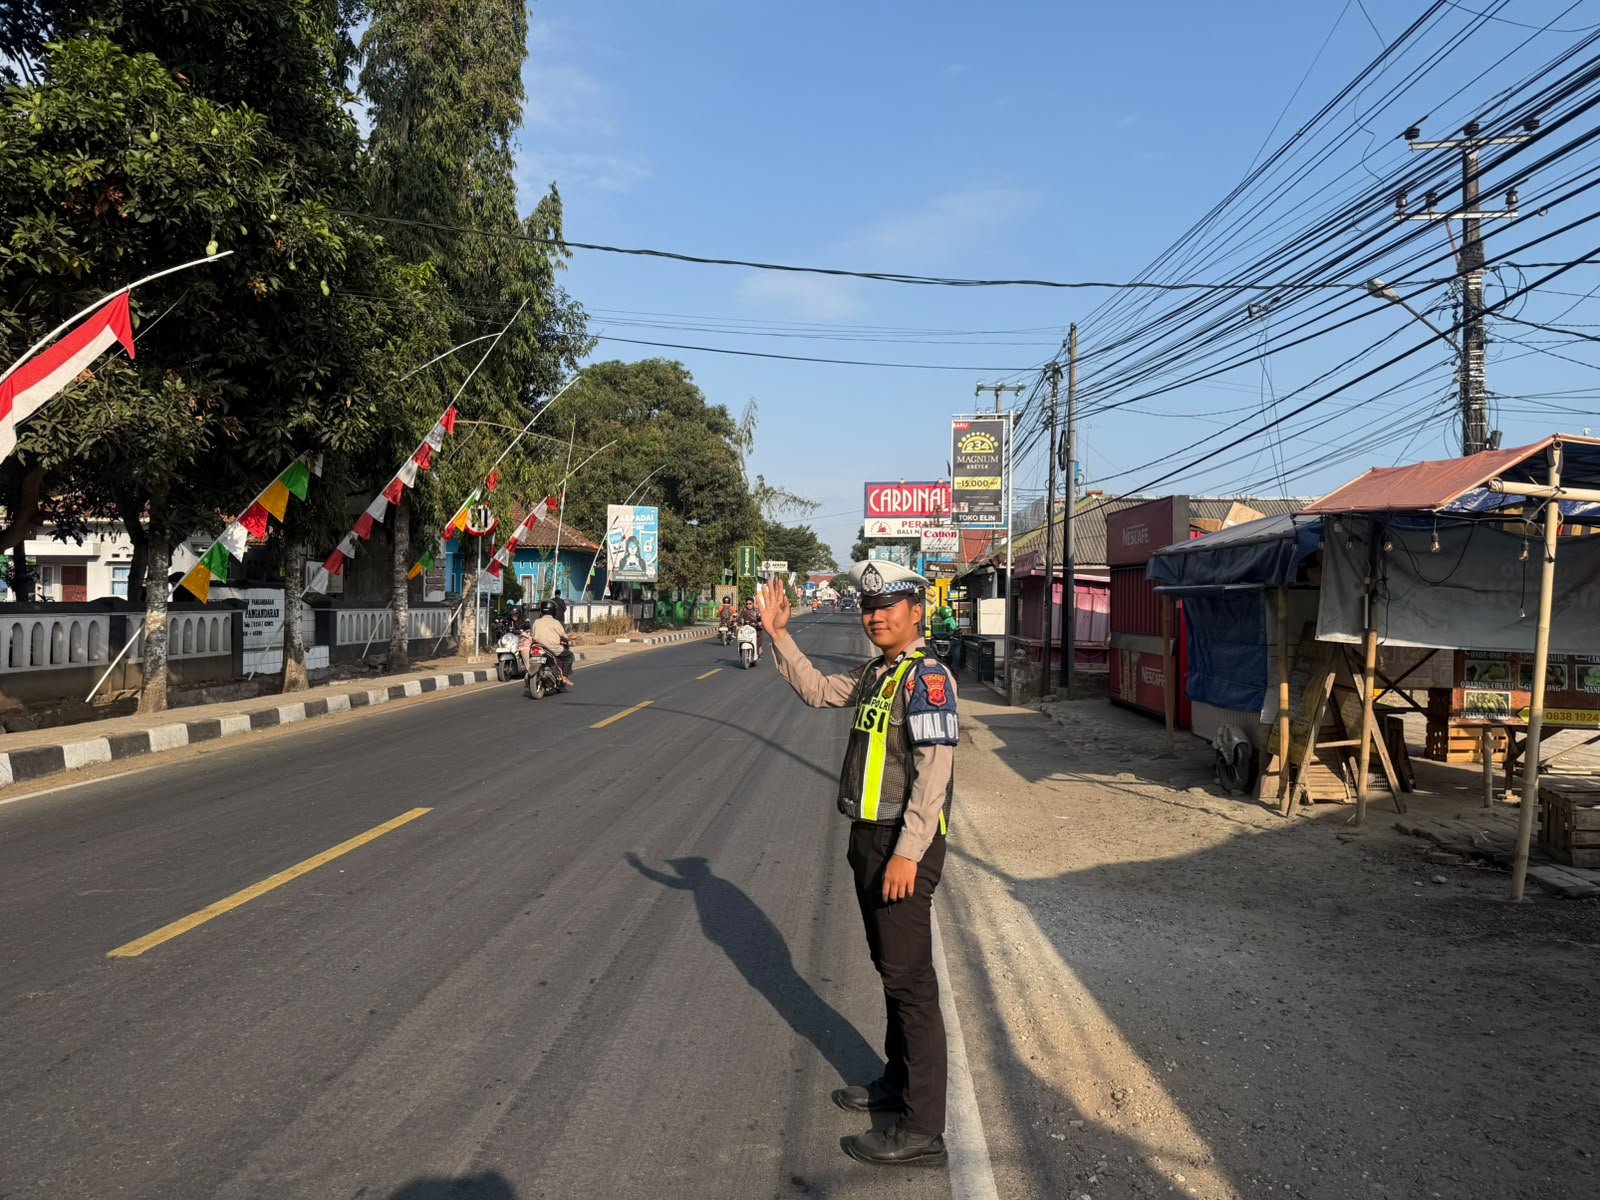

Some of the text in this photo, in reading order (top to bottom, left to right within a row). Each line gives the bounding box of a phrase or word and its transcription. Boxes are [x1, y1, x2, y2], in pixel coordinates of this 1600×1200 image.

[966, 440, 990, 450] 234
[957, 455, 999, 463] MAGNUM
[869, 488, 949, 512] CARDINAL
[924, 530, 957, 538] Canon
[245, 609, 279, 618] PANGANDARAN
[871, 699, 891, 711] POLRI
[1546, 711, 1600, 721] 0838 1924
[909, 713, 945, 741] WAL
